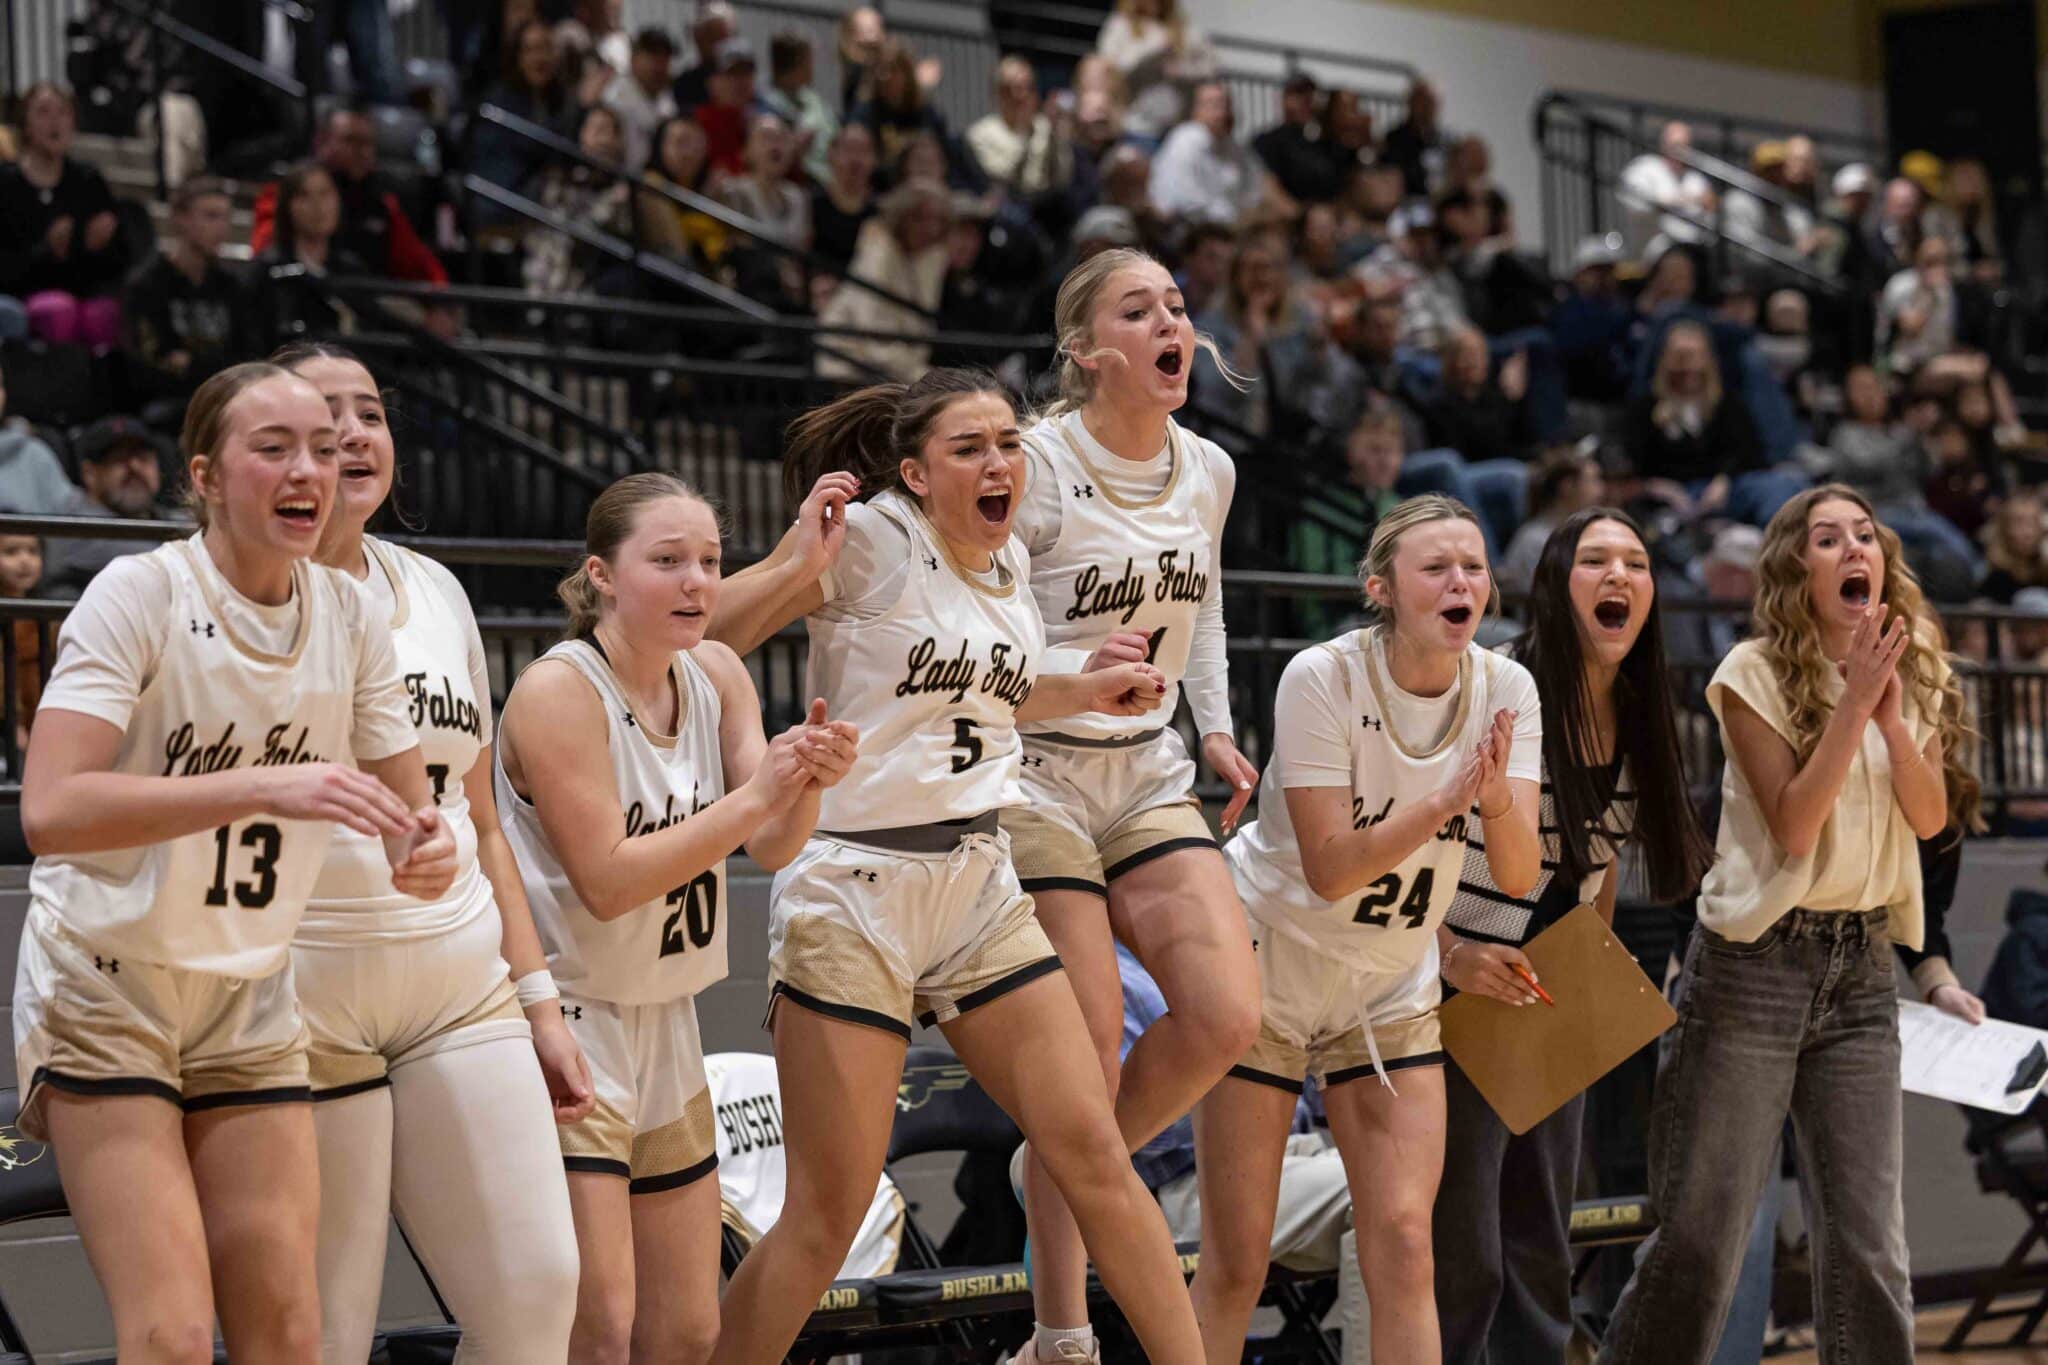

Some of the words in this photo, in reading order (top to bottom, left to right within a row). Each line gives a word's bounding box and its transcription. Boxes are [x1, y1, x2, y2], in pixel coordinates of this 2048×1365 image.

[1065, 557, 1145, 625] Lady
[1155, 549, 1208, 604] Falco
[895, 637, 977, 705] Lady
[404, 671, 482, 742] Falco
[951, 717, 984, 774] 5
[425, 764, 449, 806] 7
[205, 822, 282, 909] 13
[1352, 867, 1435, 929] 24
[658, 869, 718, 960] 20
